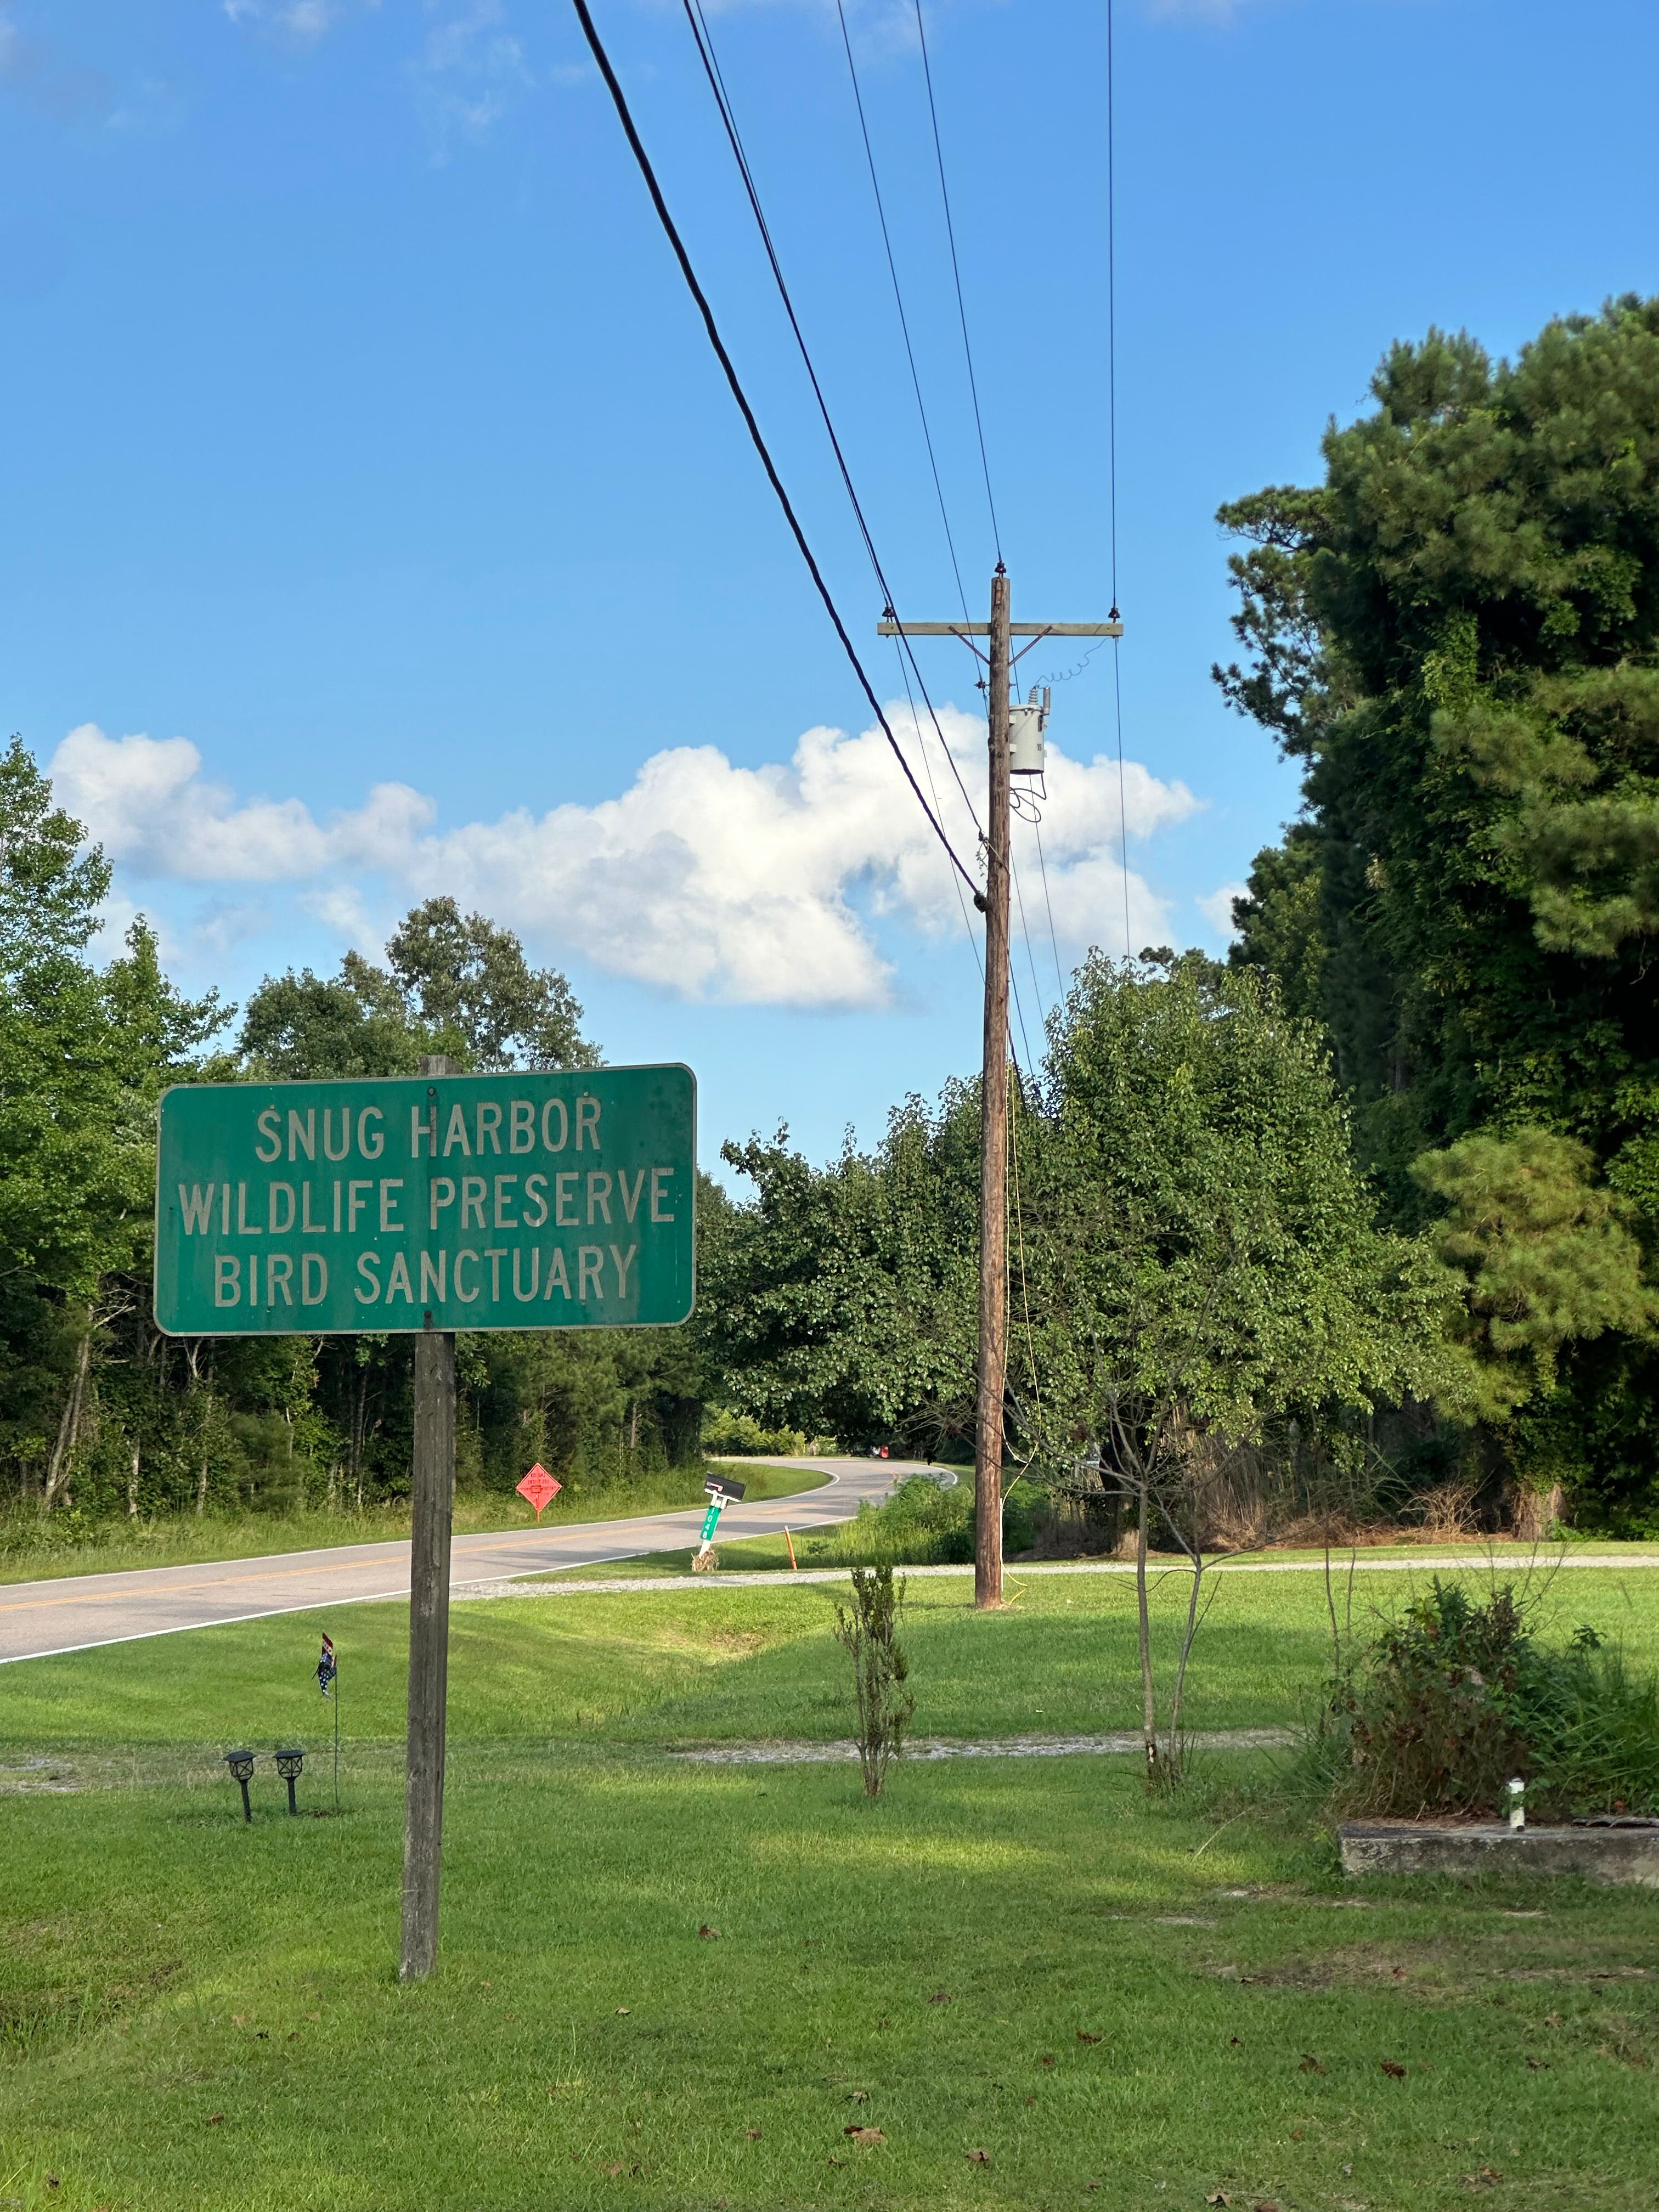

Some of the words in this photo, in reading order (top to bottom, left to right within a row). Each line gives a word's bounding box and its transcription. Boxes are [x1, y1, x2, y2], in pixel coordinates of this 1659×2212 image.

[255, 1105, 385, 1162] SNUG
[411, 1097, 601, 1158] HARBOR
[178, 1179, 404, 1235] WILDLIFE
[430, 1168, 674, 1230] PRESERVE
[215, 1254, 328, 1307] BIRD
[354, 1244, 637, 1304] SANCTUARY
[703, 1508, 714, 1538] 1048
